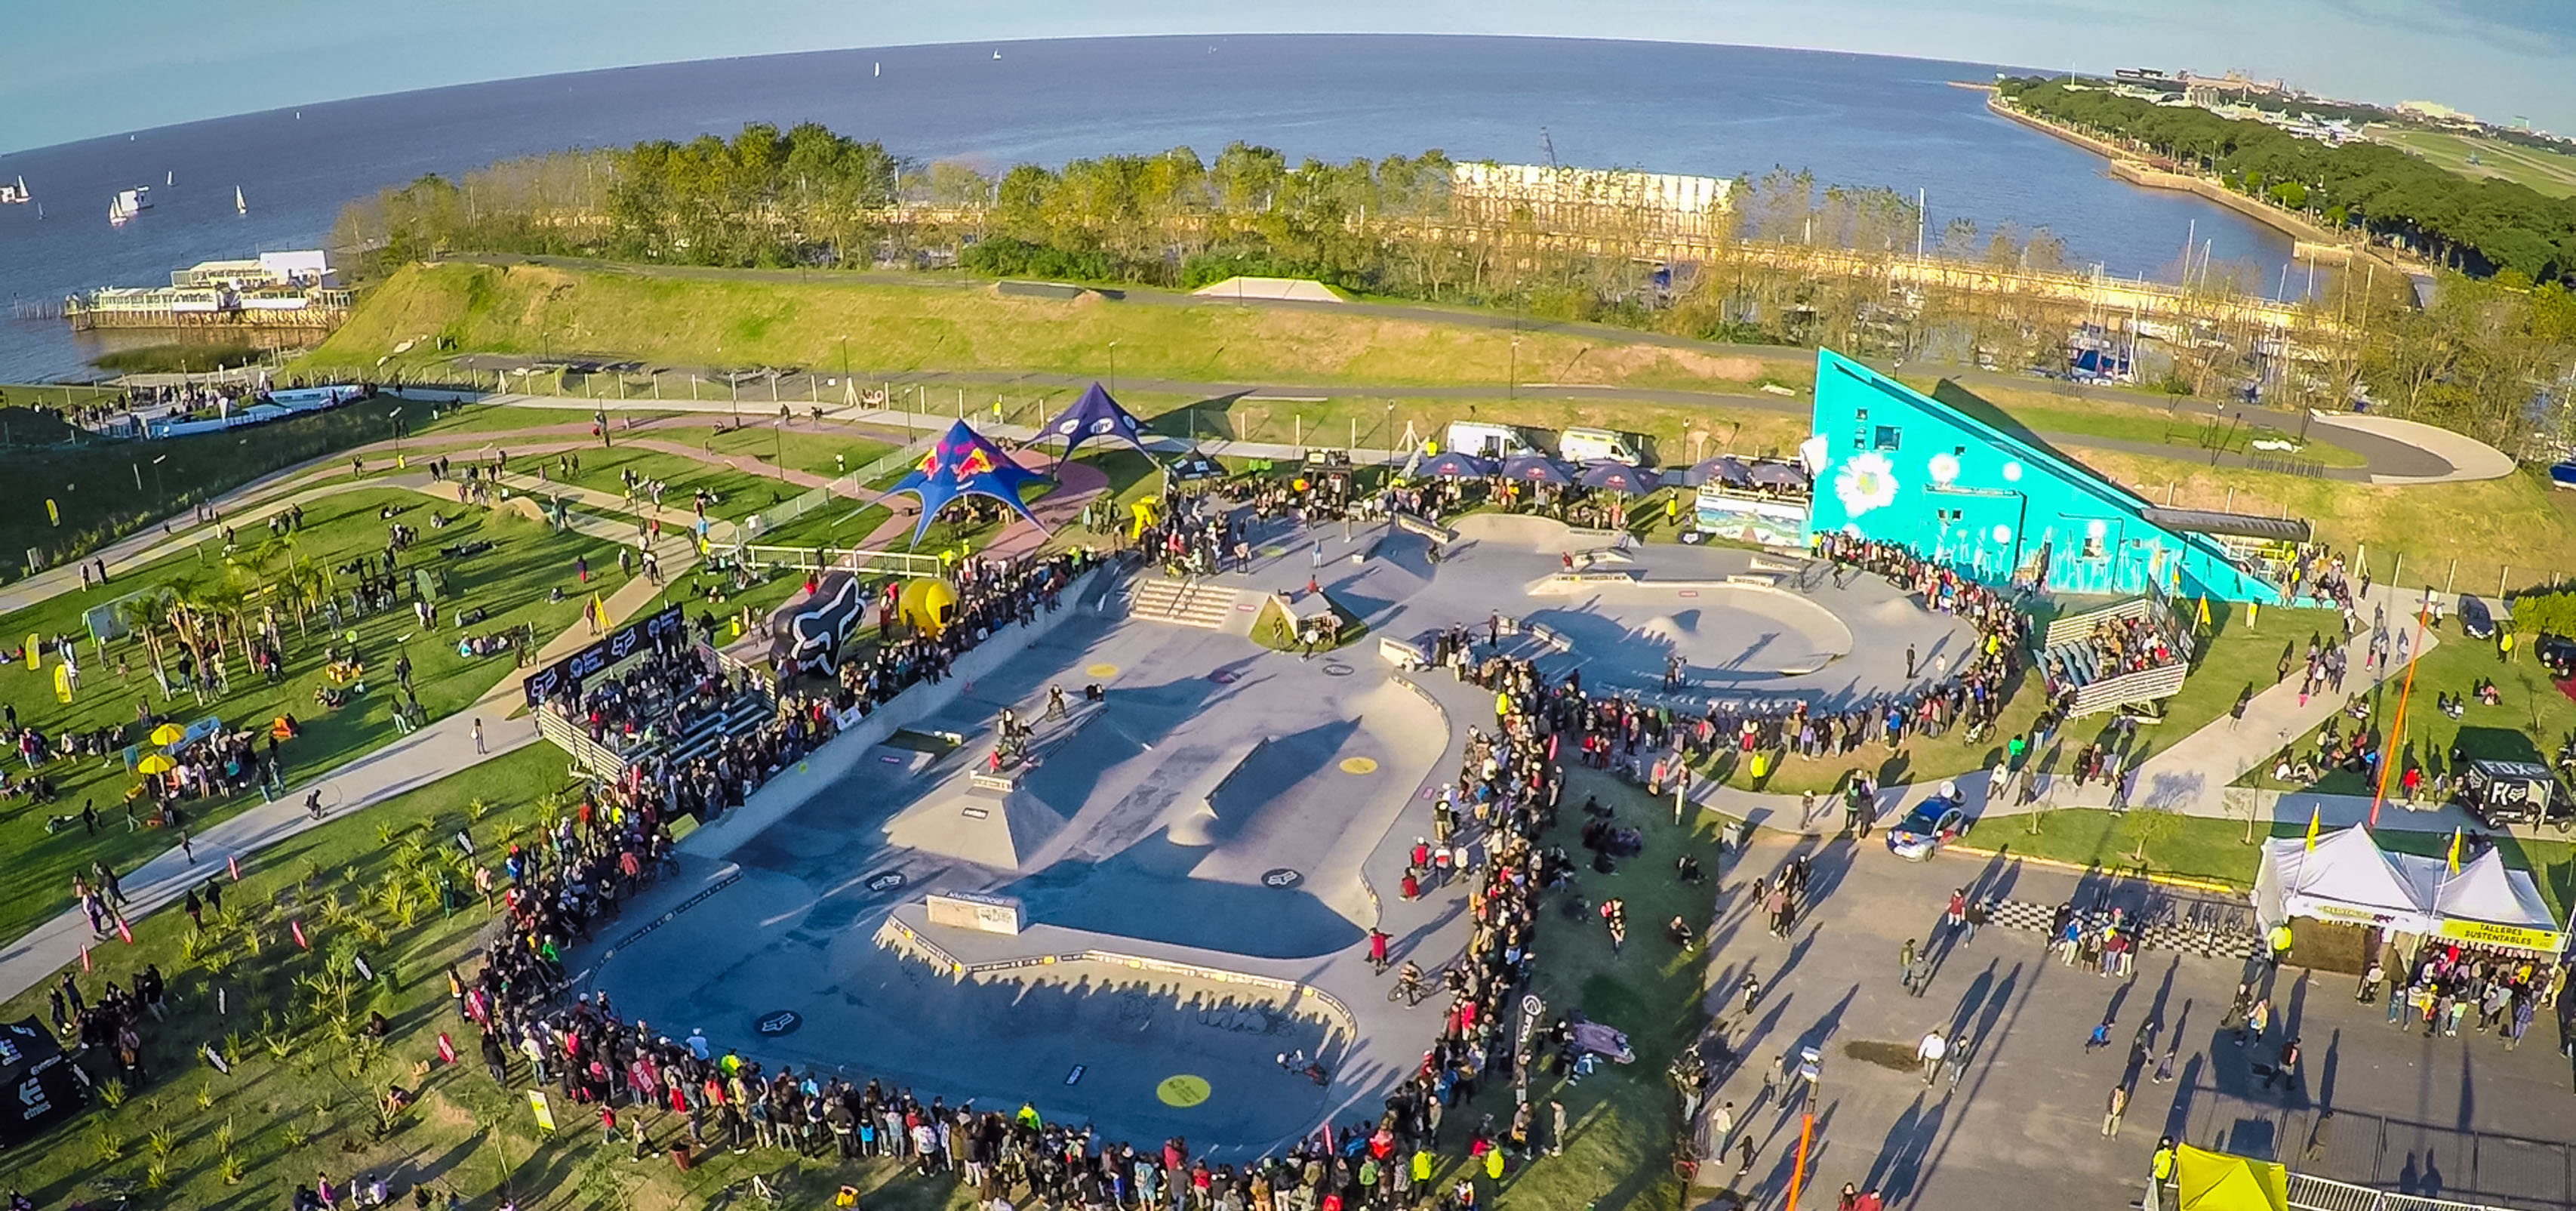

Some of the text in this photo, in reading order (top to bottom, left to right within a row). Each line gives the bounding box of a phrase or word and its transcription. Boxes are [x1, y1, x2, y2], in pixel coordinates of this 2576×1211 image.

[2480, 760, 2531, 775] FOX
[2464, 929, 2532, 945] SUSTENTABLES
[2480, 923, 2523, 936] TALLERES
